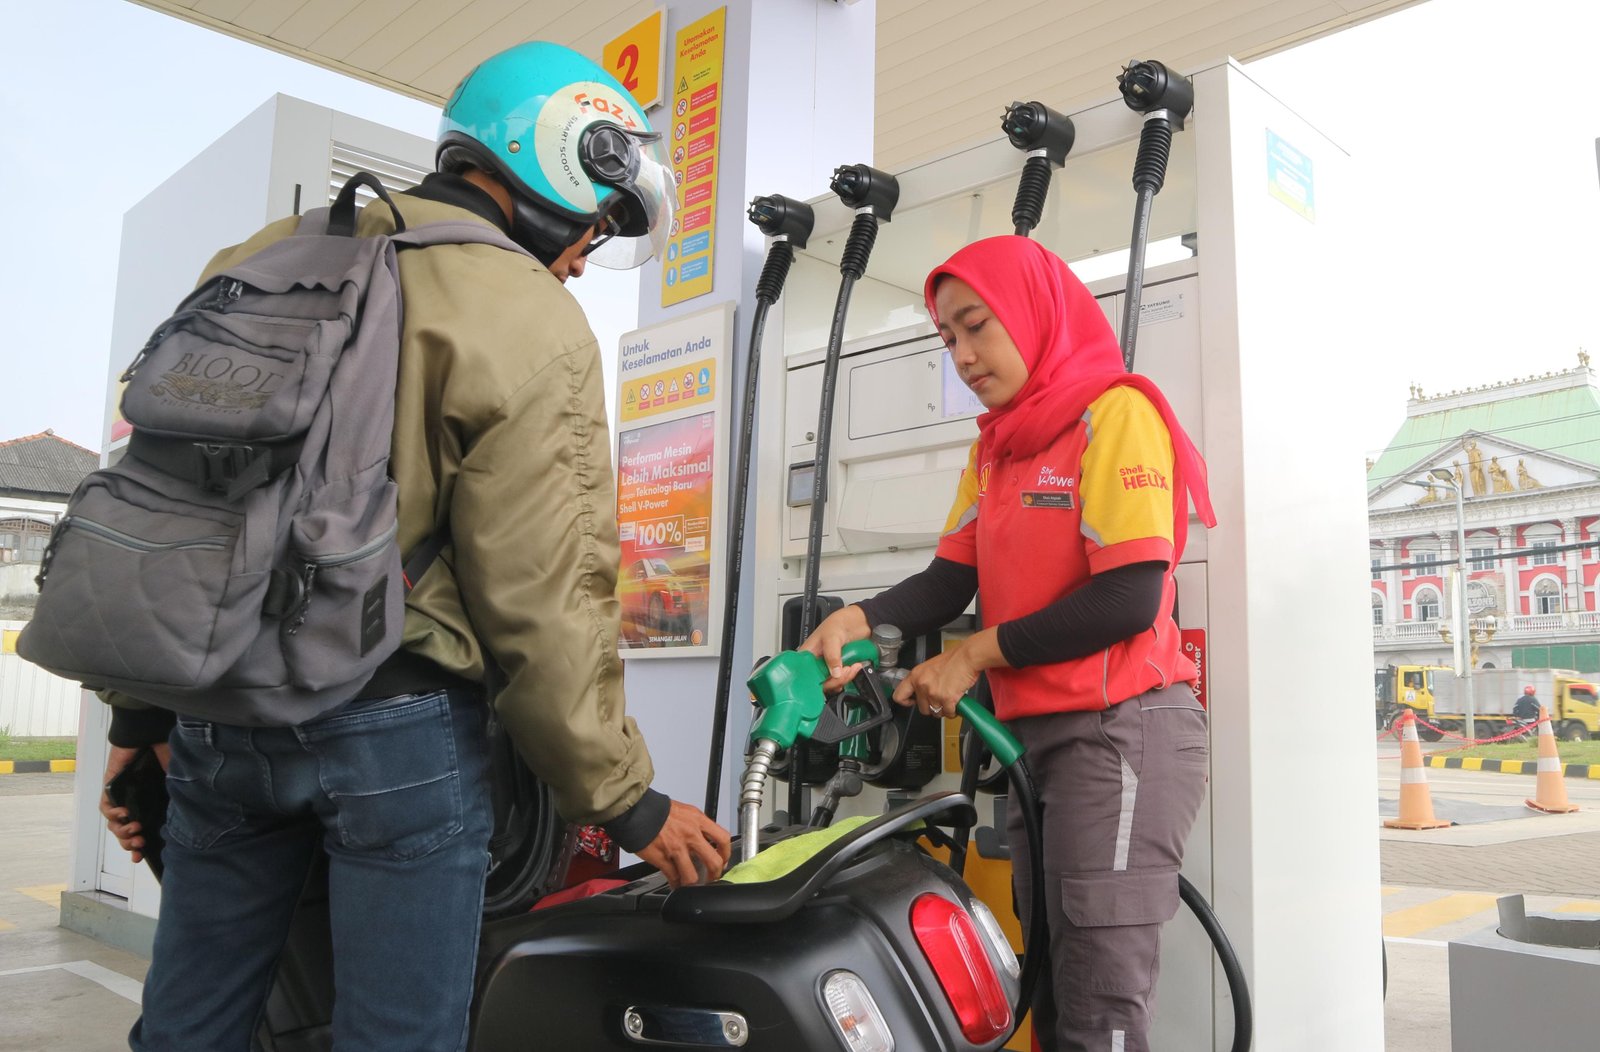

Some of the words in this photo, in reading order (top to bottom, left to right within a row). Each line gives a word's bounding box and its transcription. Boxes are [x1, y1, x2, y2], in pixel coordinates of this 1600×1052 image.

[680, 33, 719, 58] Keselamatan
[684, 26, 715, 46] Utamakan
[690, 48, 707, 62] Anda
[617, 44, 639, 92] 2
[560, 116, 578, 142] SMART
[560, 147, 580, 187] SCOOTER
[622, 338, 650, 357] Untuk
[622, 347, 682, 371] Keselamatan
[685, 336, 711, 354] Anda
[928, 361, 936, 371] Rp
[928, 403, 936, 412] Rp
[622, 452, 662, 467] Performa
[664, 443, 692, 458] Mesin
[621, 467, 649, 486] Lebih
[651, 455, 711, 480] Maksimal
[1119, 464, 1143, 476] Shell
[636, 483, 672, 497] Teknologi
[673, 480, 692, 492] Baru
[1037, 475, 1074, 487] V-owe
[1122, 473, 1169, 490] HELIX
[620, 502, 637, 514] Shell
[638, 499, 669, 511] V-Power
[639, 520, 682, 546] 100%
